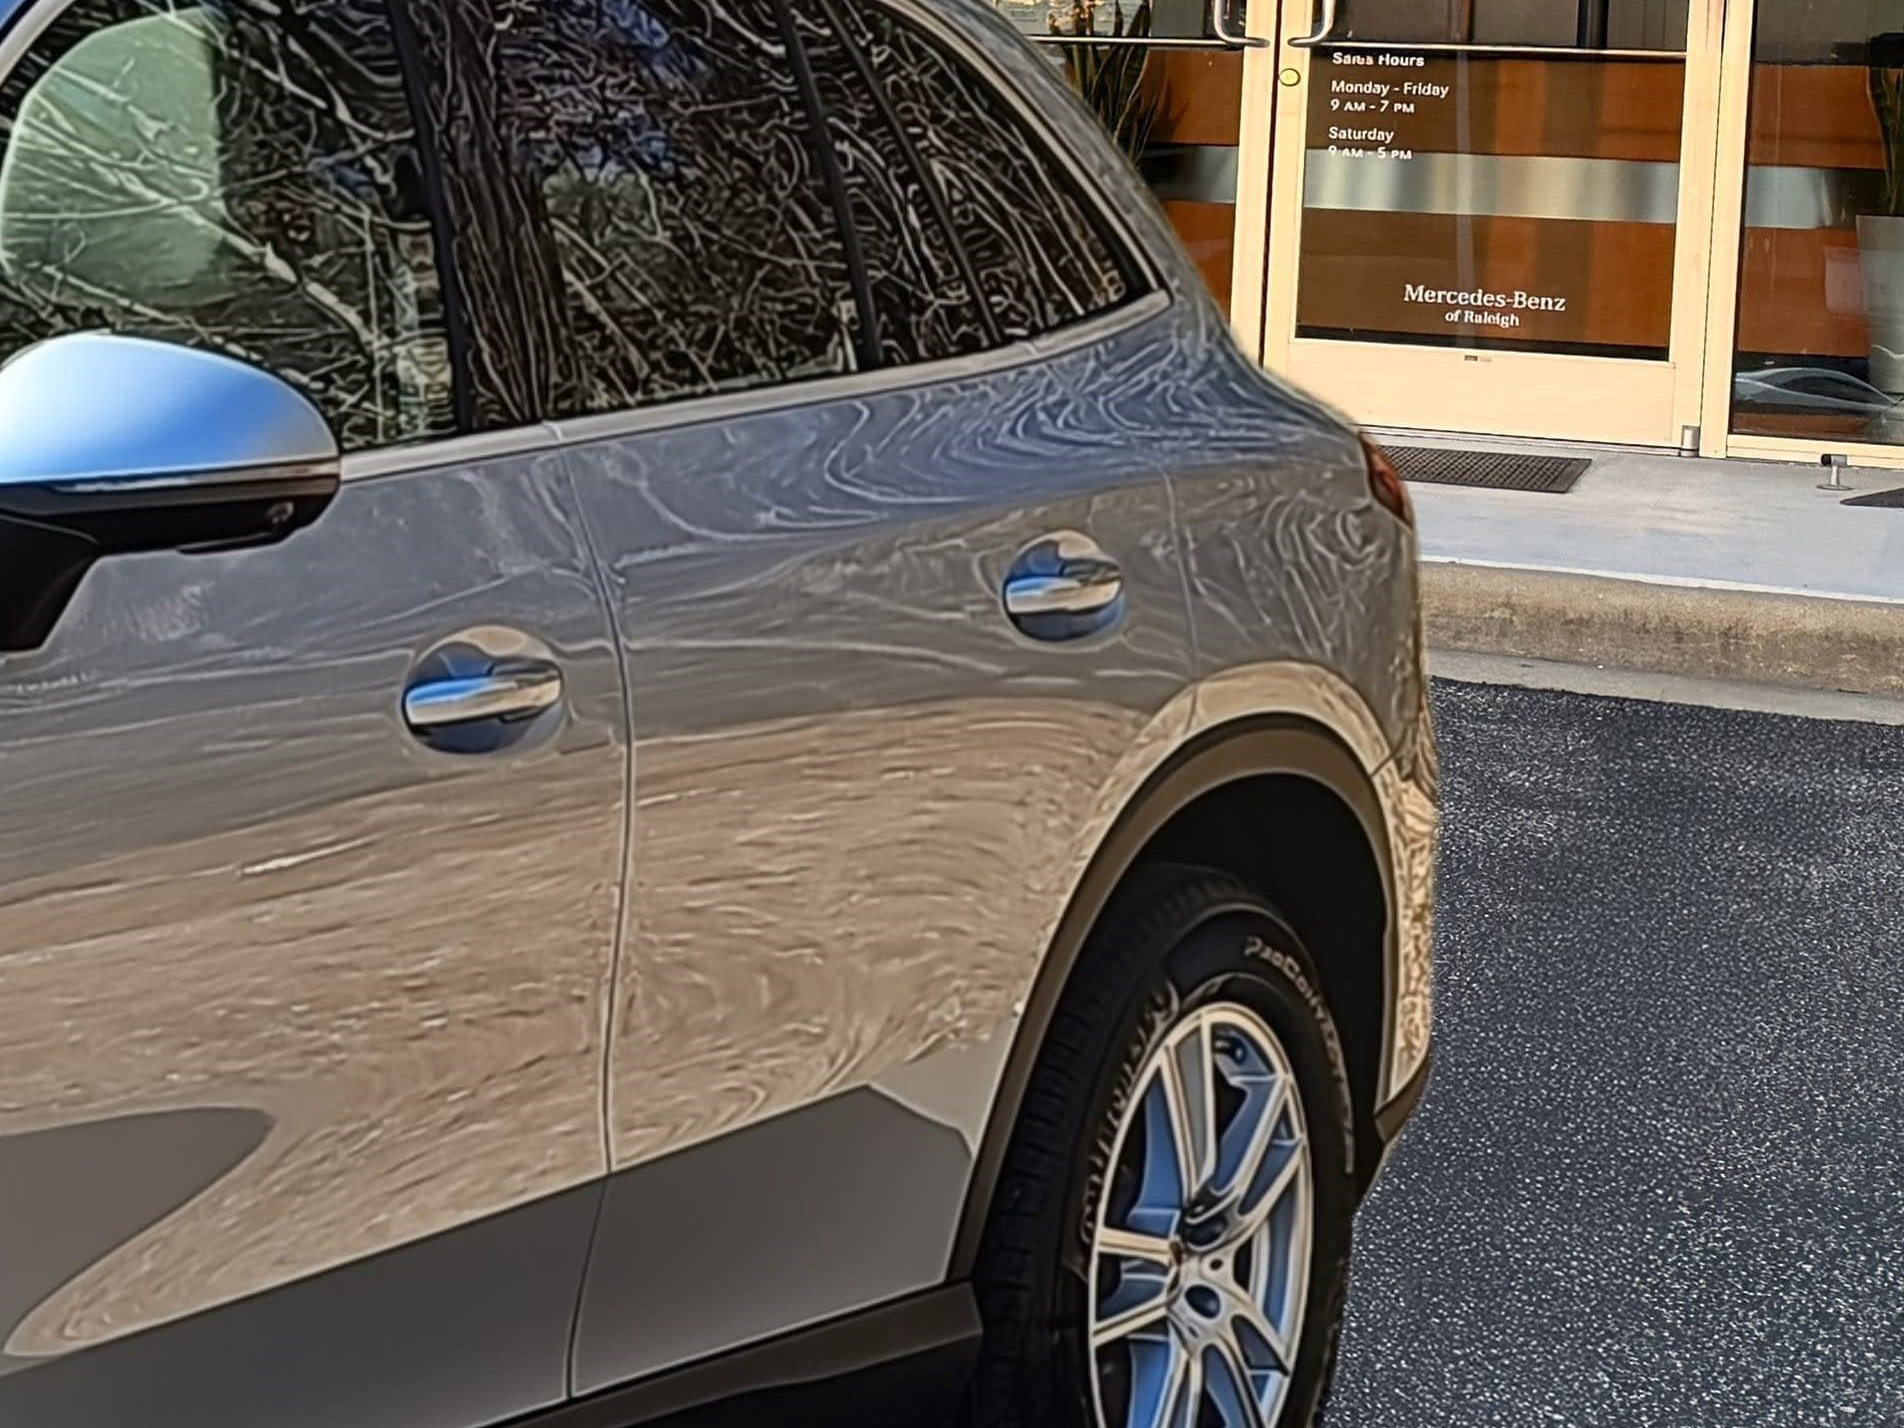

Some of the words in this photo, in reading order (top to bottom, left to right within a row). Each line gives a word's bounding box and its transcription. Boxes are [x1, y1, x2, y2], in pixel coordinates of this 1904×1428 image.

[1378, 53, 1425, 67] Hours
[1331, 79, 1390, 98] Monday
[1403, 82, 1450, 99] Friday
[1330, 98, 1340, 112] 9
[1343, 101, 1366, 112] AM
[1379, 99, 1390, 113] 7
[1393, 102, 1415, 114] PM
[1328, 126, 1395, 145] Saturday
[1377, 146, 1387, 159] 5
[1403, 283, 1567, 312] Mercedes-Benz
[1445, 309, 1462, 323] of
[1464, 310, 1521, 329] Raleigh
